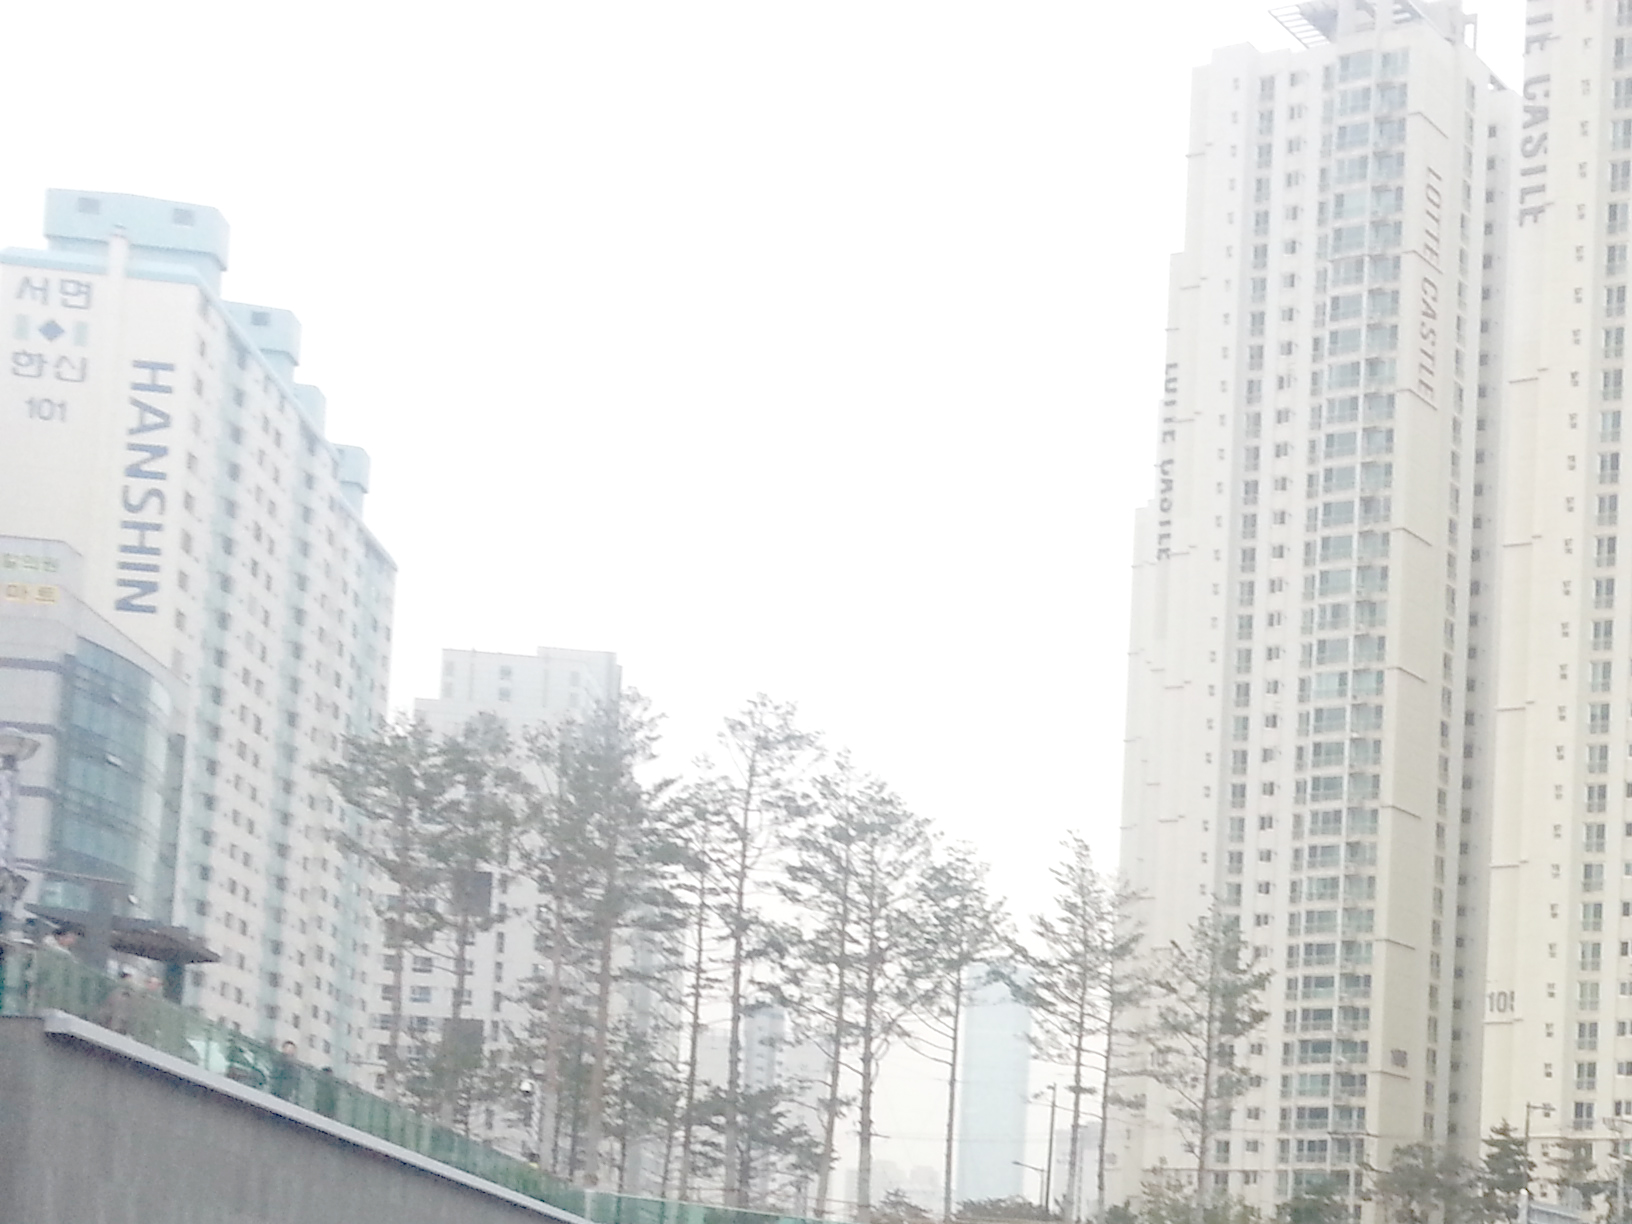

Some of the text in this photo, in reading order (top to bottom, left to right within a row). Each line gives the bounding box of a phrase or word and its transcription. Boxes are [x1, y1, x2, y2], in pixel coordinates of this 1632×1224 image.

[17, 275, 92, 310] 서면
[1417, 165, 1443, 398] LOTTE CASTLE
[11, 350, 88, 383] 한신
[25, 397, 67, 423] 101
[112, 359, 176, 615] HANSHIN
